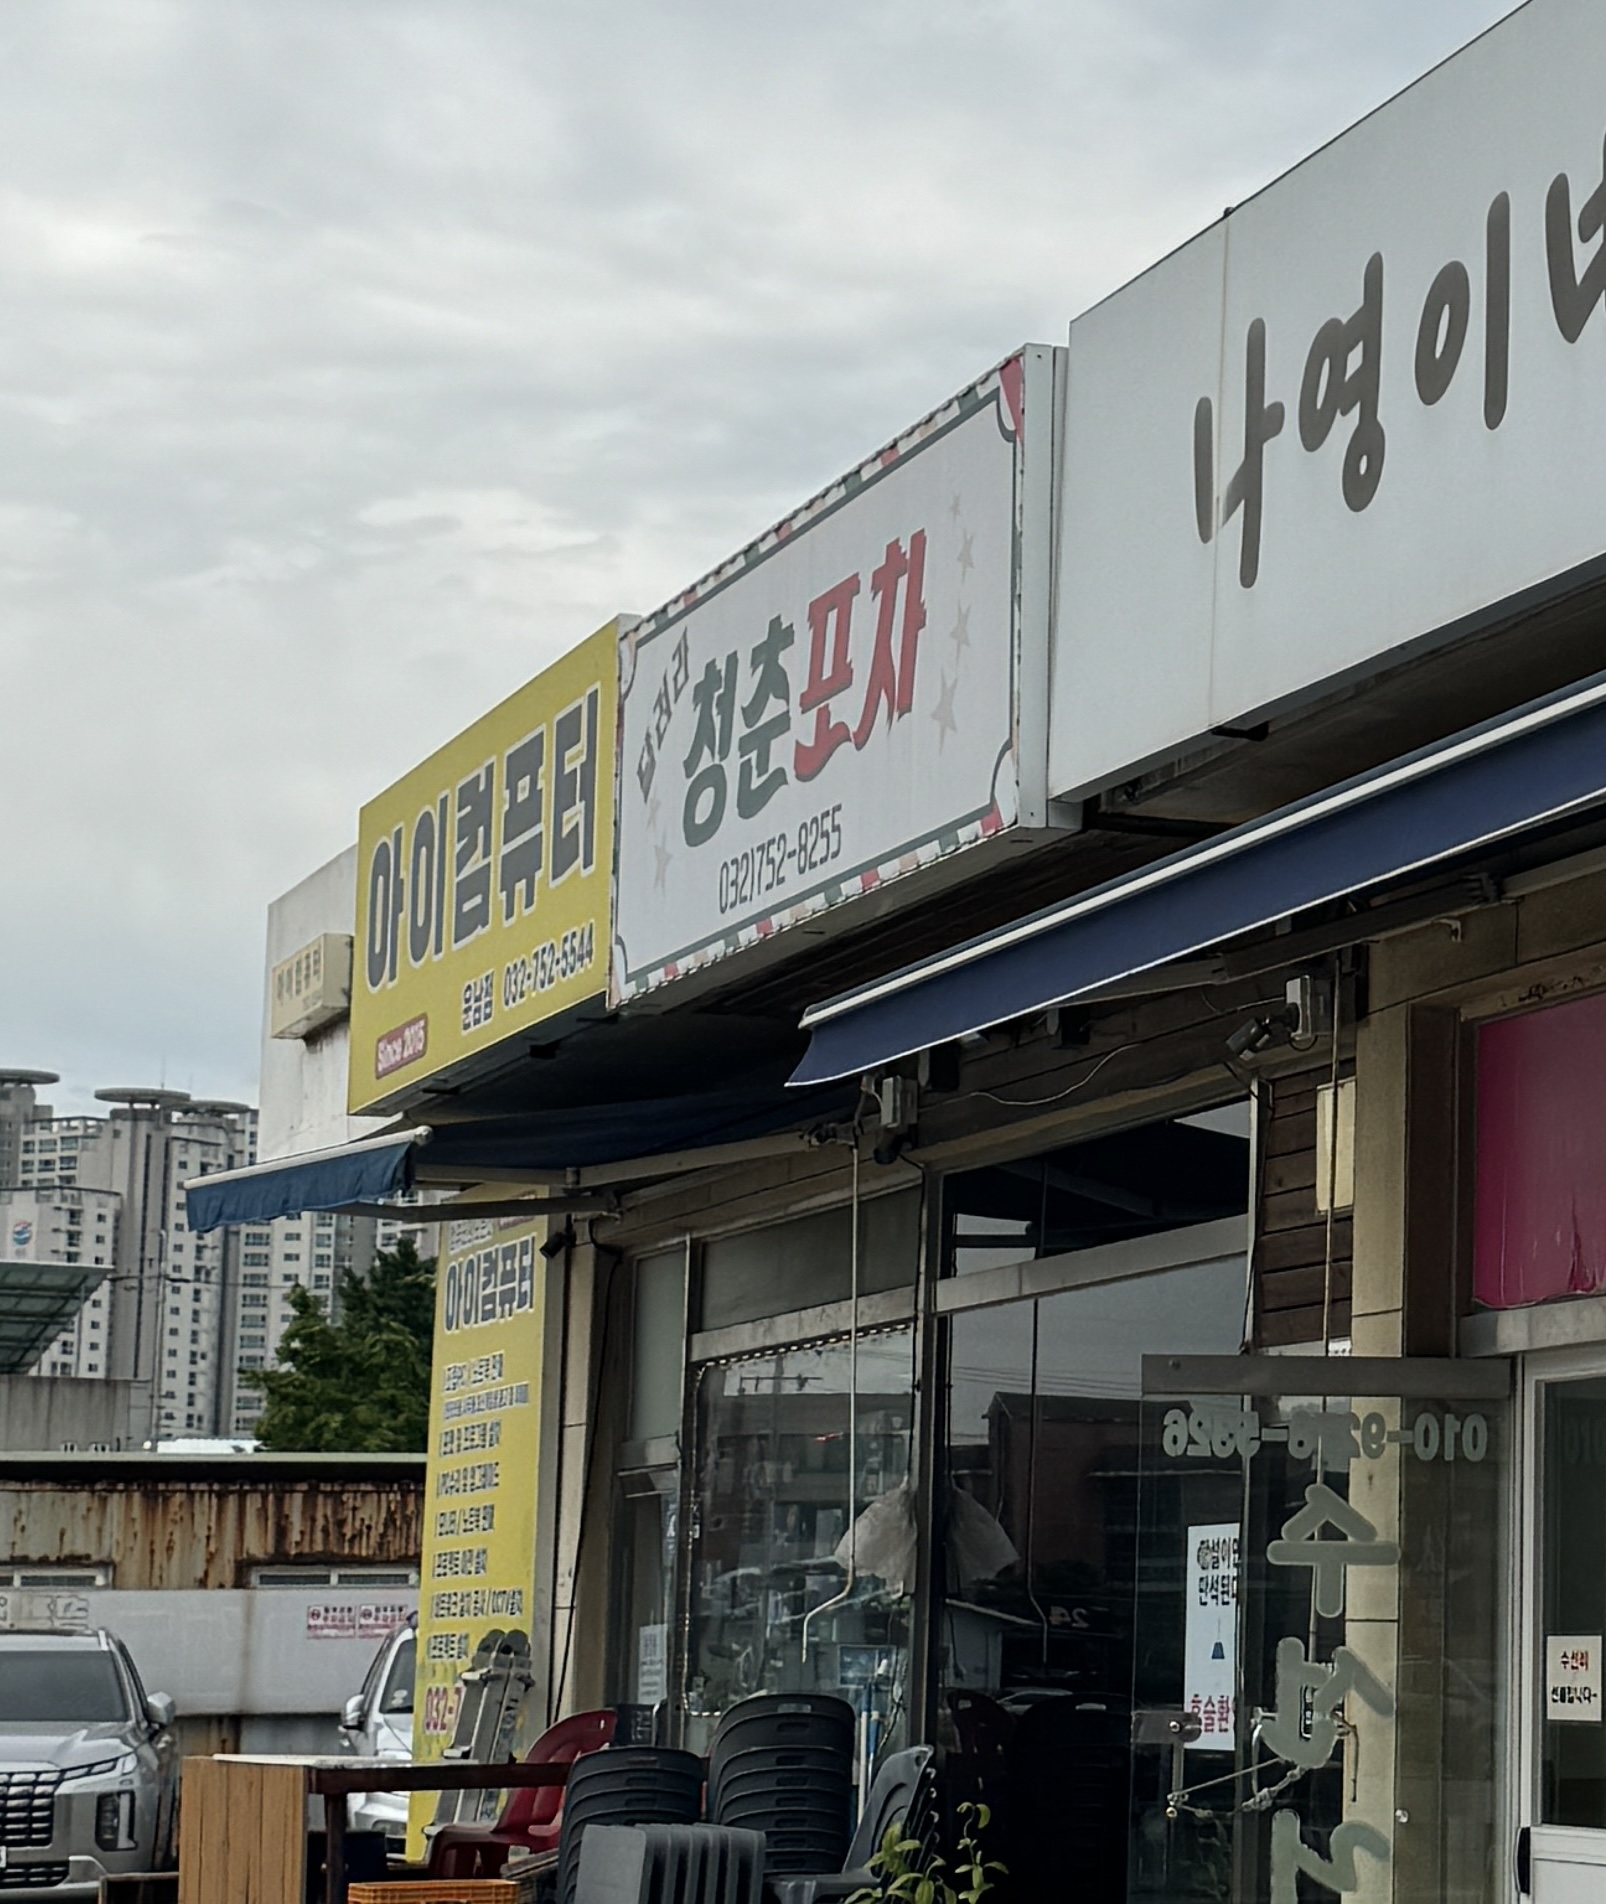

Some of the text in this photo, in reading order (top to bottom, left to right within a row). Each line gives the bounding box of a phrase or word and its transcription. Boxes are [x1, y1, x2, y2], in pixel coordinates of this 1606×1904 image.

[365, 682, 599, 992] 아이컴퓨터
[719, 803, 843, 914] 032)752-8255
[503, 921, 594, 1009] 032-752-5544
[444, 1233, 537, 1333] 아이컴퓨터
